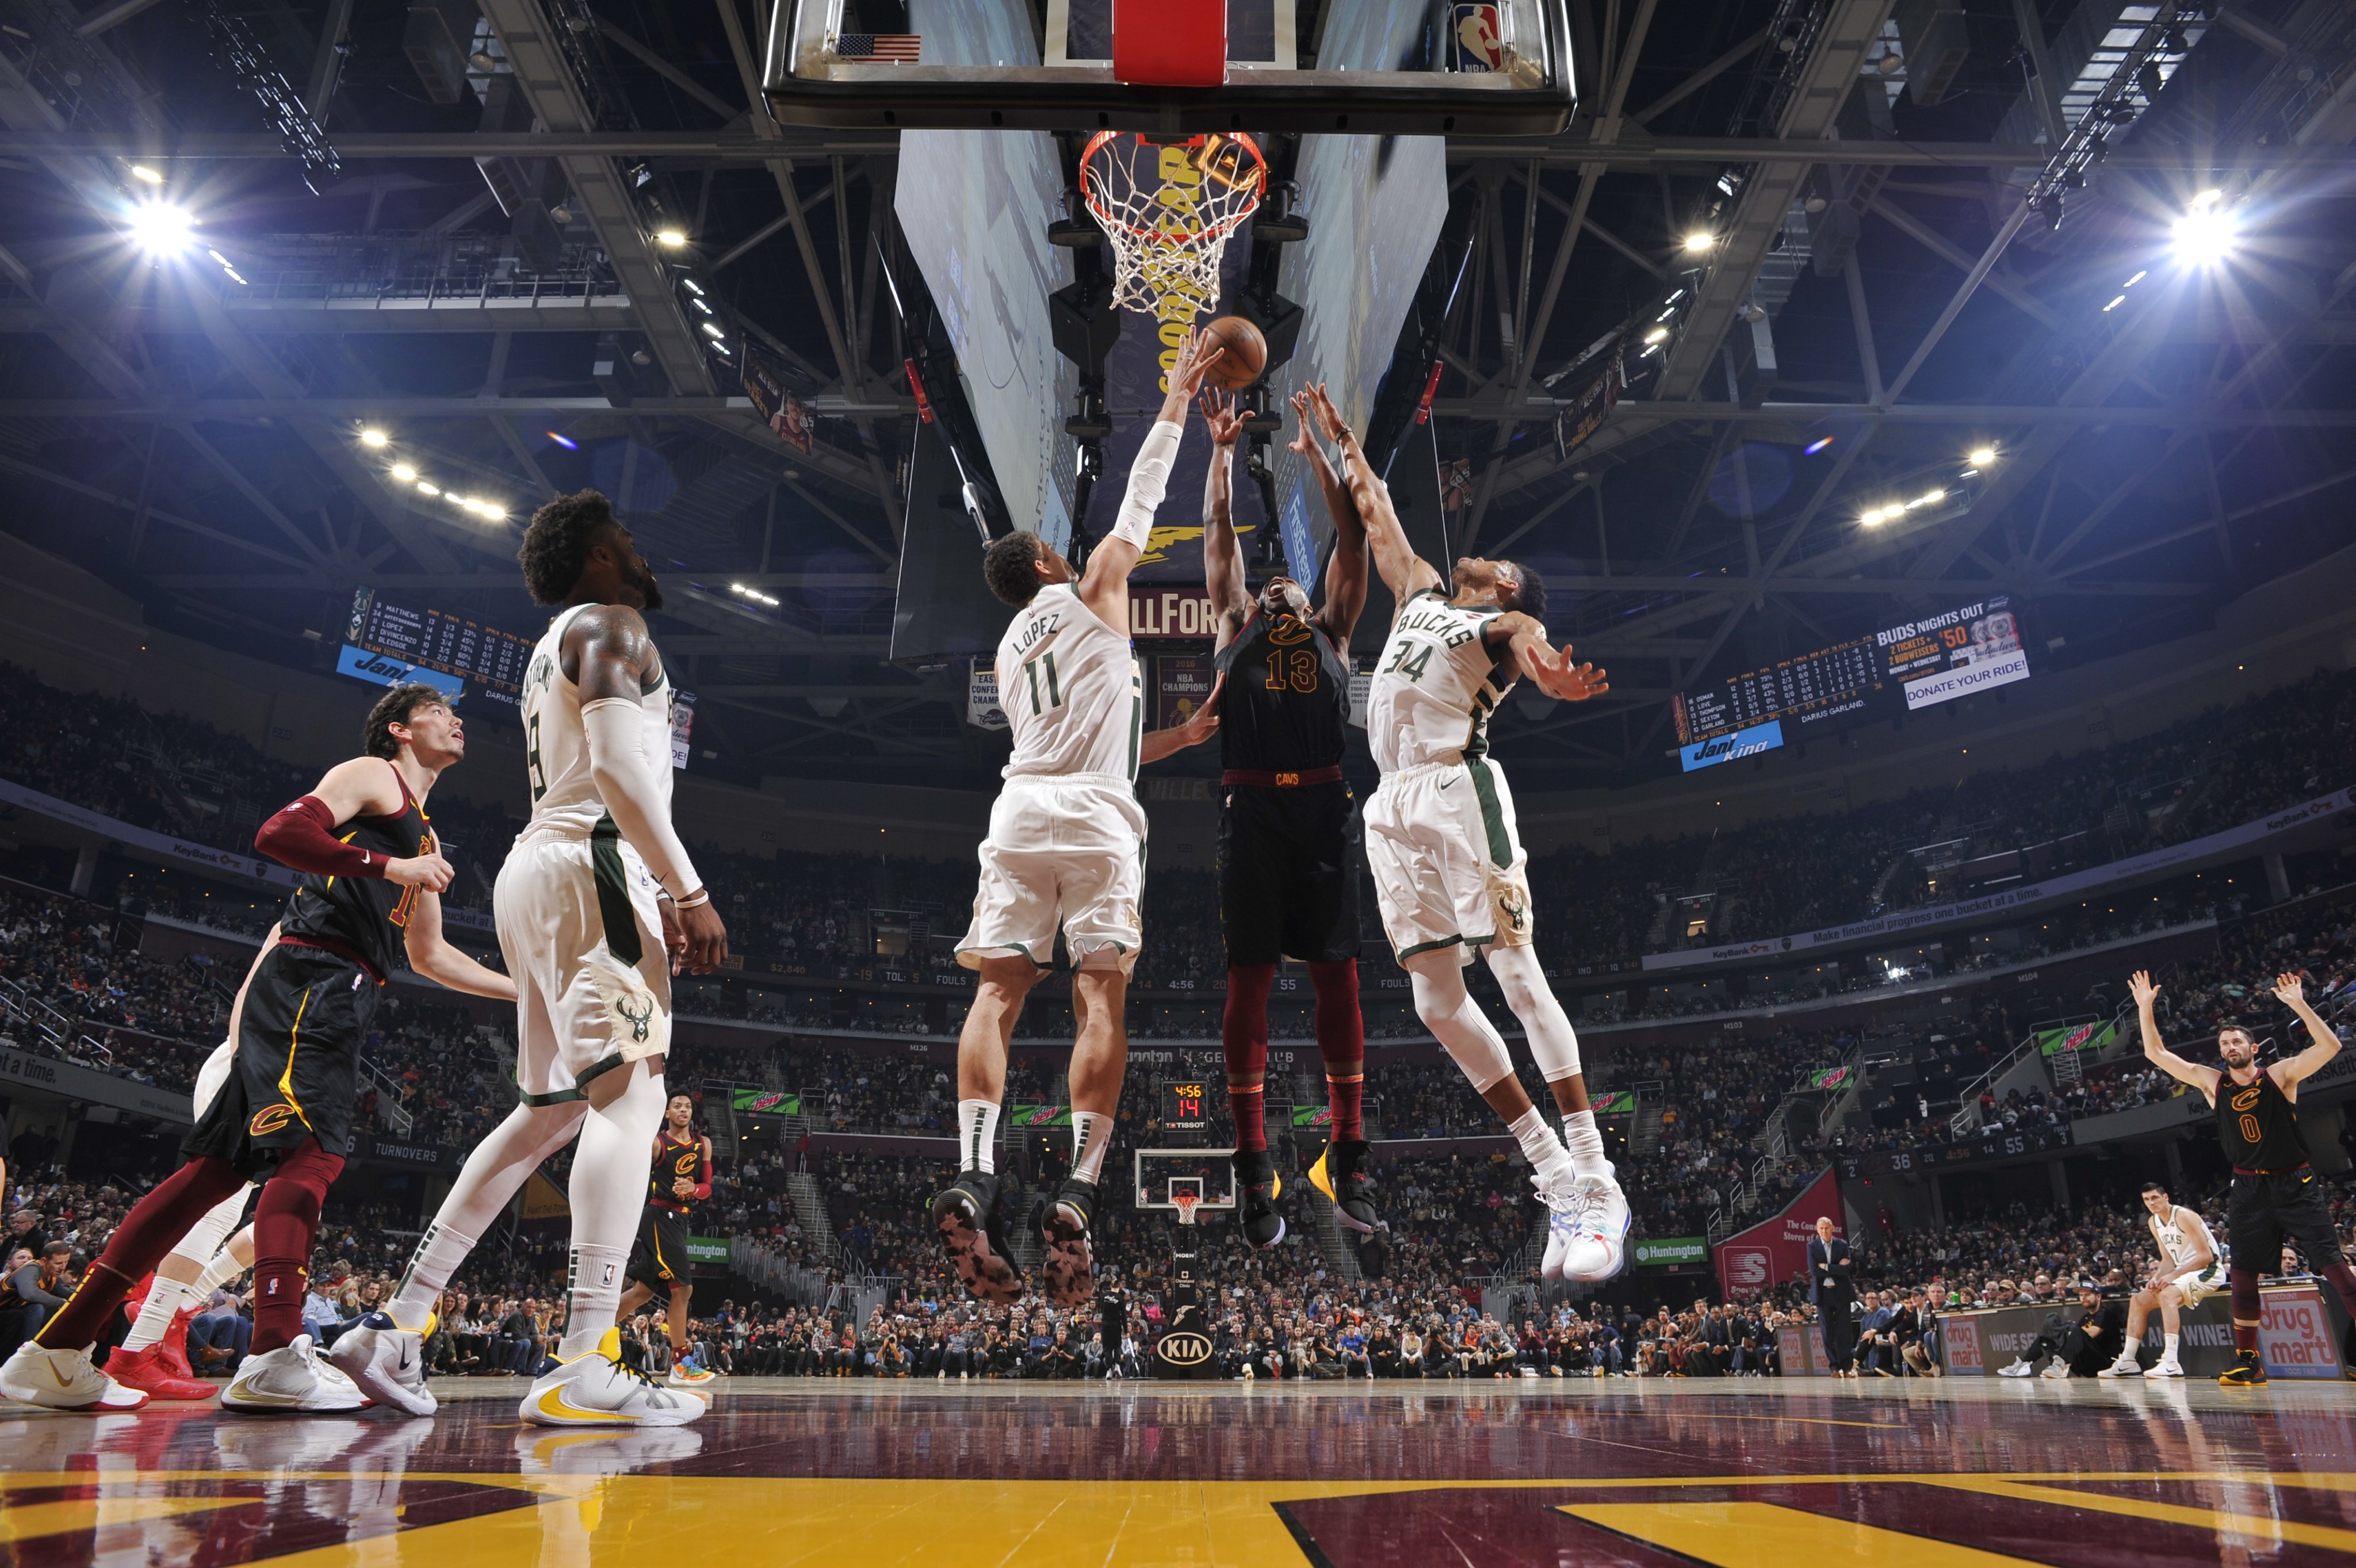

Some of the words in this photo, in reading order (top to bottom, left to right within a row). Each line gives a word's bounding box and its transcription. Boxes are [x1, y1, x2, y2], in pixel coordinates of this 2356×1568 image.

[1465, 64, 1486, 73] NBA
[382, 621, 403, 632] LOPEZ
[386, 605, 419, 620] MATTHEWS
[463, 629, 476, 638] 33%
[1877, 623, 1916, 647] BUDS
[1917, 610, 1959, 633] NIGHTS
[1960, 603, 1983, 620] OUT
[380, 629, 417, 644] DIVINCENZO
[442, 631, 454, 640] 5/11
[1012, 613, 1060, 655] LOPEZ
[1395, 613, 1475, 651] BUCKS
[1938, 625, 1968, 649] $50
[378, 636, 407, 650] BLEDSOE
[1890, 645, 1896, 655] 2
[1896, 636, 1926, 653] TICKETS
[364, 643, 381, 653] TEAM
[384, 648, 407, 660] TOTALS
[1888, 656, 1895, 666] 2
[1895, 643, 1940, 664] BUDWEISERS
[354, 655, 416, 680] Jani
[1382, 640, 1434, 684] 34
[1889, 663, 1909, 675] MONDAY
[1913, 654, 1942, 668] WEDNESDAY
[1265, 649, 1317, 693] 13
[1024, 649, 1063, 718] 11
[1177, 674, 1194, 683] NBA
[1907, 680, 1956, 702] DONATE
[1956, 670, 1992, 688] YOUR
[1993, 659, 2027, 678] RIDE!
[1162, 683, 1208, 691] CHAMPIONS
[486, 690, 514, 704] DARIUS
[1696, 693, 1714, 702] OSMAN
[1697, 701, 1711, 710] LOVE
[1699, 704, 1726, 717] THOMPSON
[1802, 710, 1828, 723] DARIUS
[1829, 699, 1866, 715] GARLAND.
[1700, 713, 1720, 724] SEXTON
[1701, 719, 1725, 731] GARLAND
[1695, 734, 1708, 742] TEAM
[1709, 728, 1728, 737] TOTALS
[1693, 732, 1738, 761] Jani
[529, 711, 548, 803] 9
[1275, 773, 1299, 786] CAVS
[2267, 810, 2311, 831] KeyBank
[174, 843, 217, 863] KeyBank
[442, 907, 477, 924] bucket
[478, 916, 489, 927] at
[1713, 947, 1749, 959] KeyBank
[1813, 928, 1840, 943] Make
[1842, 920, 1885, 938] financial
[1887, 912, 1932, 932] progress
[1934, 908, 1955, 920] one
[1956, 898, 1993, 915] bucket
[1994, 894, 2006, 907] at
[2008, 894, 2015, 904] a
[2017, 885, 2043, 902] time.
[770, 963, 806, 974] $2,840
[854, 970, 873, 981] -19
[1546, 970, 1559, 978] ATL
[1578, 966, 1592, 975] IND
[1598, 965, 1606, 973] 17
[886, 972, 906, 982] TOL:
[912, 974, 919, 982] 5
[936, 975, 966, 986] FOULS
[1381, 978, 1410, 989] FOULS
[1468, 974, 1475, 984] 5
[2018, 972, 2038, 983] M104
[1138, 980, 1152, 989] 14
[1169, 980, 1194, 989] 4:56
[1280, 980, 1296, 990] 55
[1724, 1020, 1743, 1030] M103
[910, 1044, 928, 1052] M126
[10, 1058, 20, 1070] a
[24, 1057, 56, 1084] time.
[1175, 1085, 1201, 1097] 4:56
[1179, 1099, 1198, 1117] 14
[2239, 1114, 2262, 1143] 0
[2005, 1136, 2025, 1154] 55
[2061, 1133, 2067, 1145] 3
[376, 1143, 437, 1162] TURNOVERS
[1946, 1150, 1971, 1160] 4:56
[1983, 1145, 1994, 1154] 14
[1891, 1154, 1911, 1170] 36
[1849, 1167, 1856, 1177] 2
[527, 1206, 542, 1215] PAINT
[543, 1205, 553, 1213] THE
[1787, 1219, 1799, 1229] The
[1783, 1232, 1805, 1242] Stores
[1807, 1234, 1815, 1242] of
[1650, 1244, 1703, 1259] Huntington
[2171, 1249, 2179, 1263] 7
[2267, 1292, 2297, 1301] DISCOUNT
[2260, 1302, 2315, 1339] drug
[1946, 1320, 1972, 1348] drug
[2182, 1324, 2234, 1347] WINE!
[1167, 1340, 1203, 1357] KIA
[1989, 1334, 2017, 1351] WIDE
[2270, 1335, 2336, 1364] mart
[1785, 1353, 1804, 1368] mart
[1952, 1349, 1983, 1367] mart
[2285, 1367, 2303, 1375] FOOD
